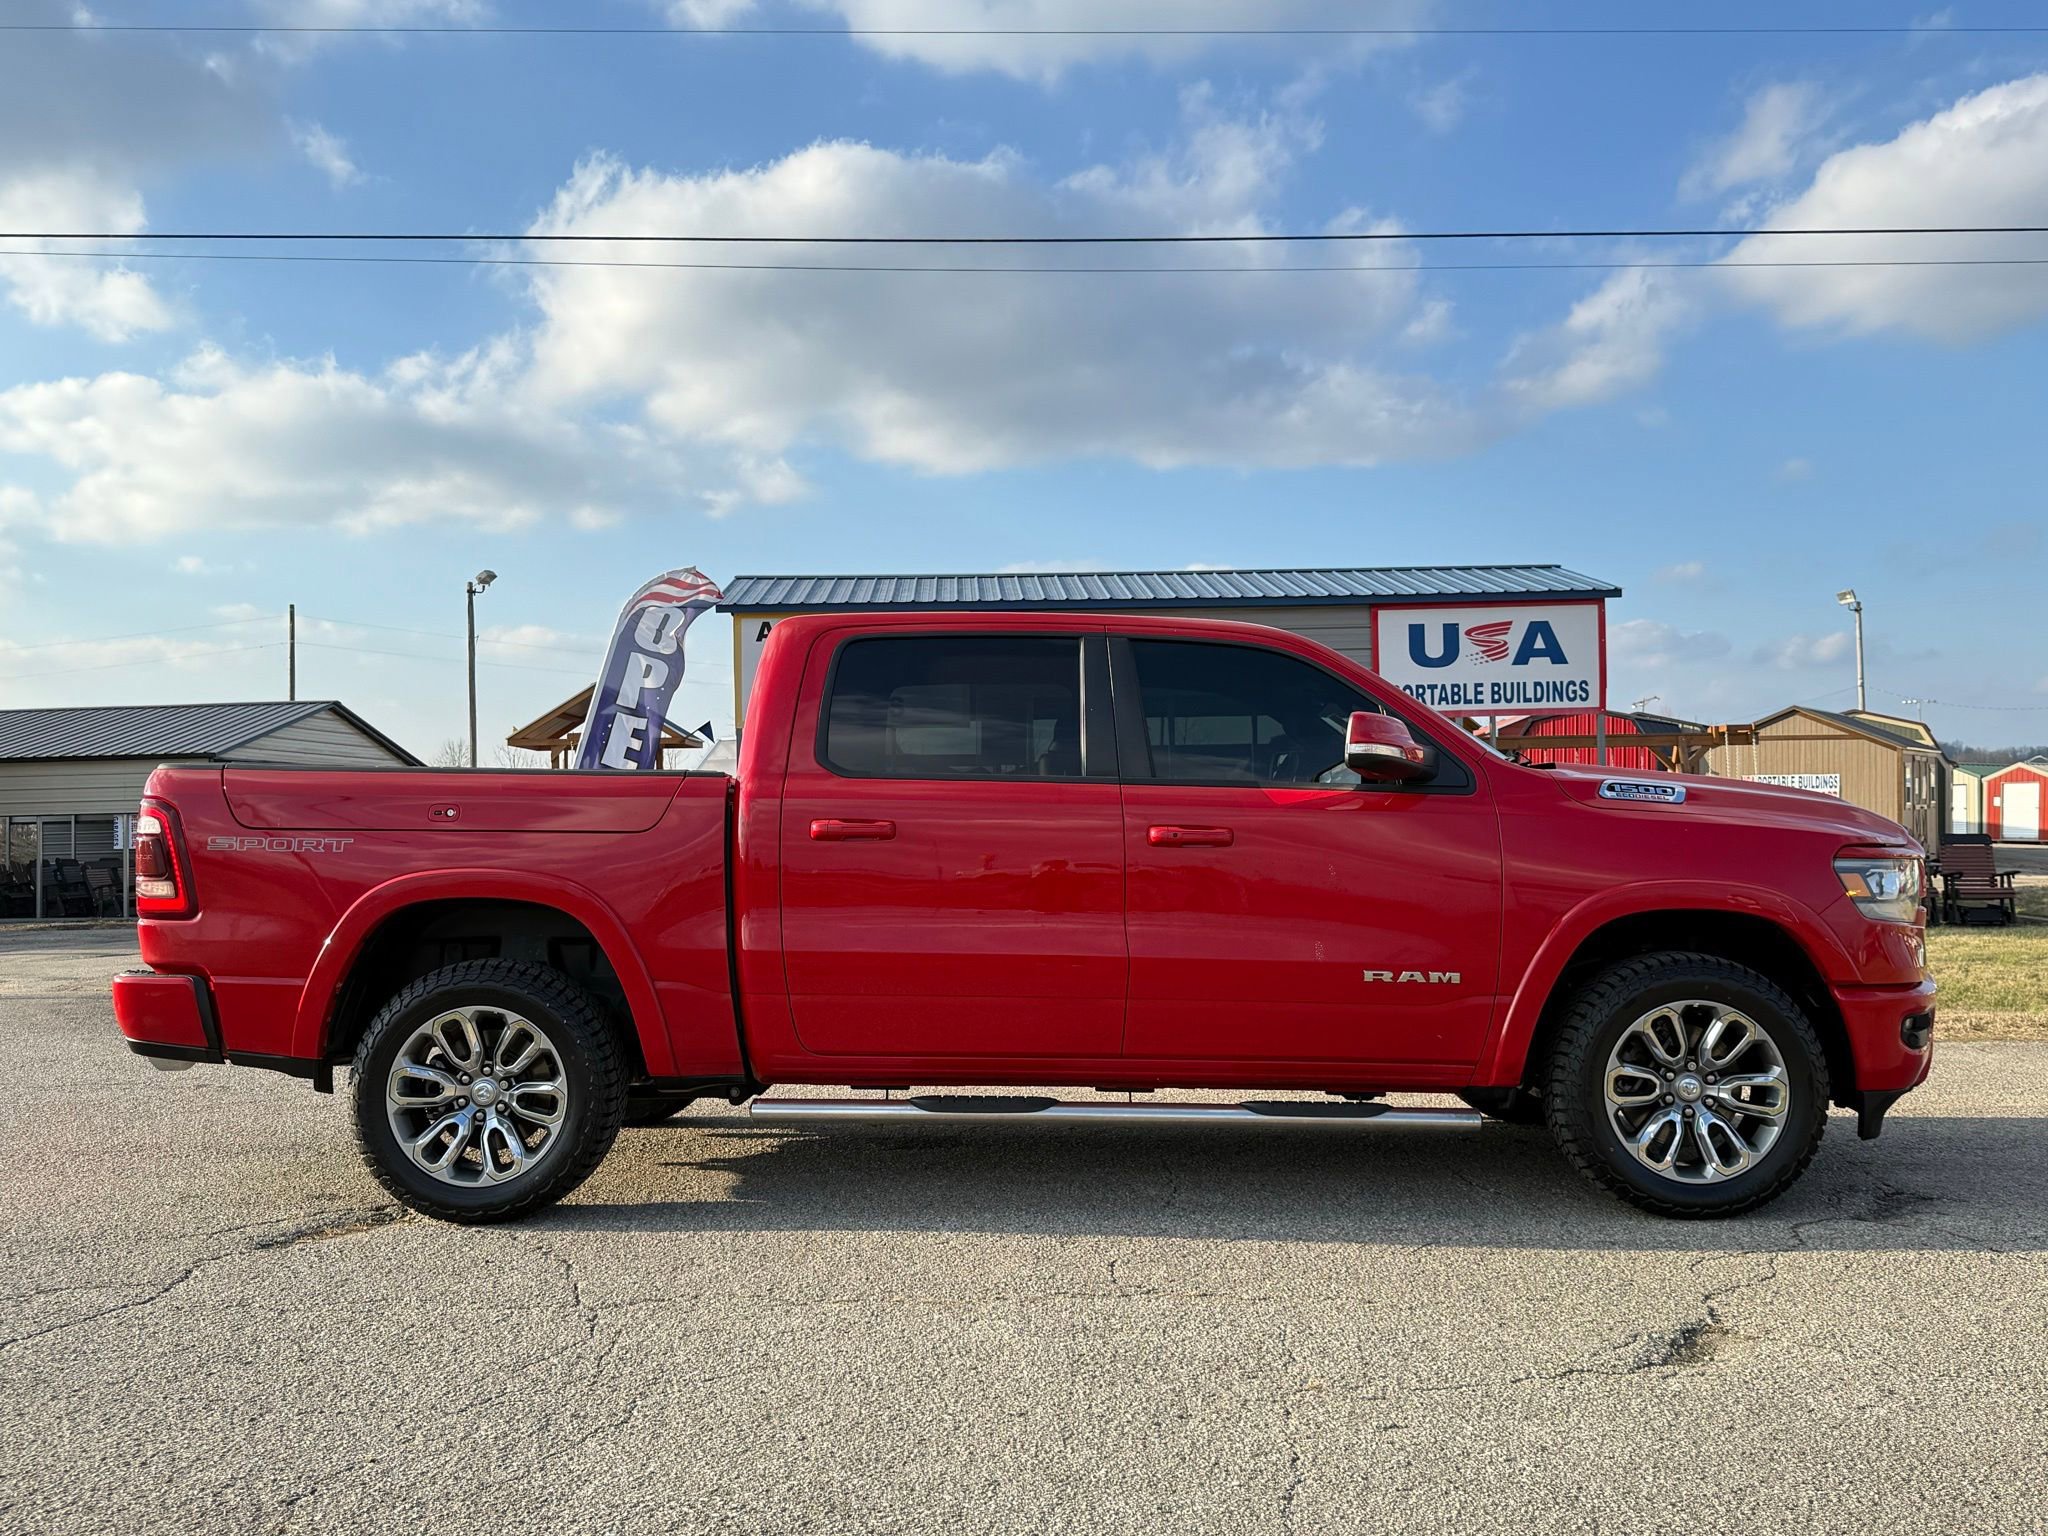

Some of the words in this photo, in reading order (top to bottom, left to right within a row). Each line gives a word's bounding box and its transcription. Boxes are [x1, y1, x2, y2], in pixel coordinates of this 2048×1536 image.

[1408, 620, 1569, 668] USA
[1395, 682, 1484, 705] ORTABLE
[1491, 680, 1590, 704] BUILDINGS
[1611, 783, 1673, 796] 1500
[1799, 775, 1838, 789] BUILDINGS
[207, 836, 354, 853] SPORT
[1363, 970, 1461, 984] RAM
